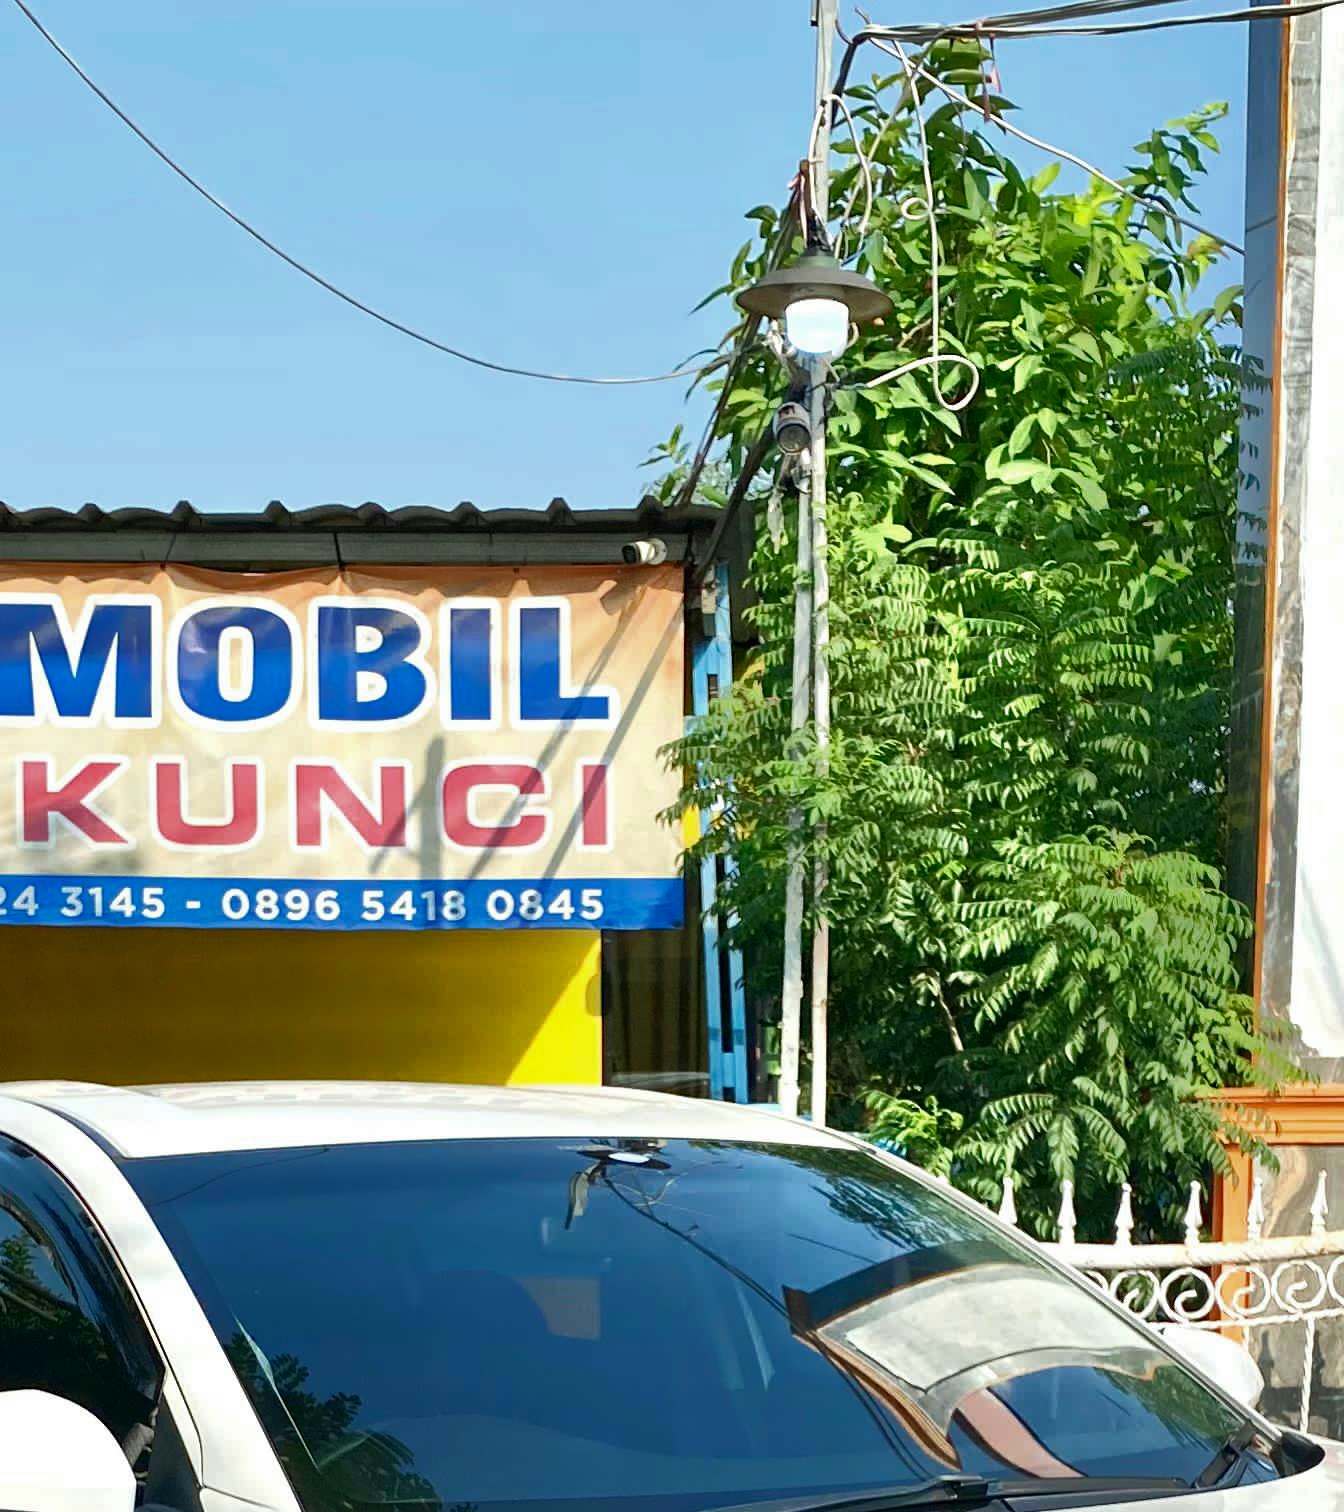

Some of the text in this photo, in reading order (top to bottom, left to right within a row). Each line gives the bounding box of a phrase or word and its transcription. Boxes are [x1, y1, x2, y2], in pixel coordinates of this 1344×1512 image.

[23, 761, 607, 848] KUNCI
[60, 886, 165, 919] 3145
[222, 888, 341, 921] 0896
[361, 889, 466, 921] 5418
[486, 888, 604, 921] 0845
